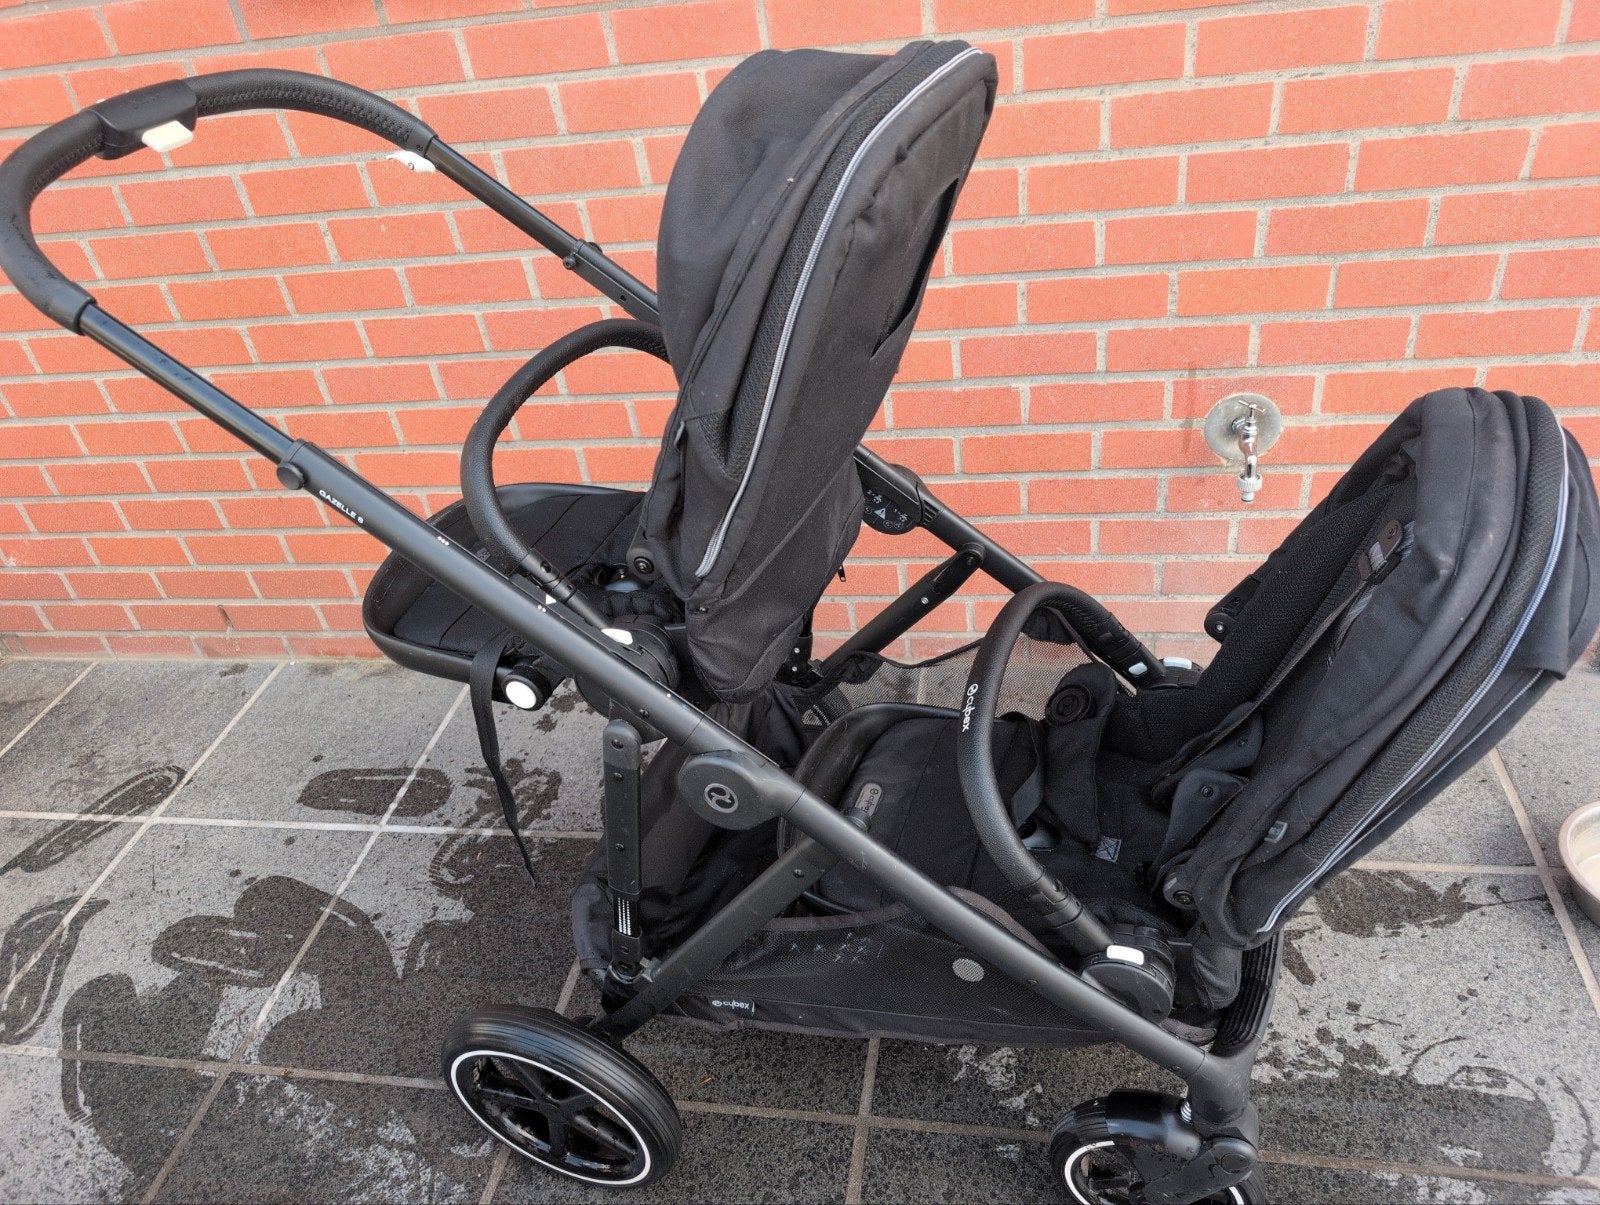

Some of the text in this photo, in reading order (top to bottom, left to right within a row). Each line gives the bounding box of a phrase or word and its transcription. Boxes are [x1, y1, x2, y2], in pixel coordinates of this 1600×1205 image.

[319, 489, 357, 519] GAZELLE
[962, 696, 975, 733] cybex
[723, 999, 750, 1010] cybex
